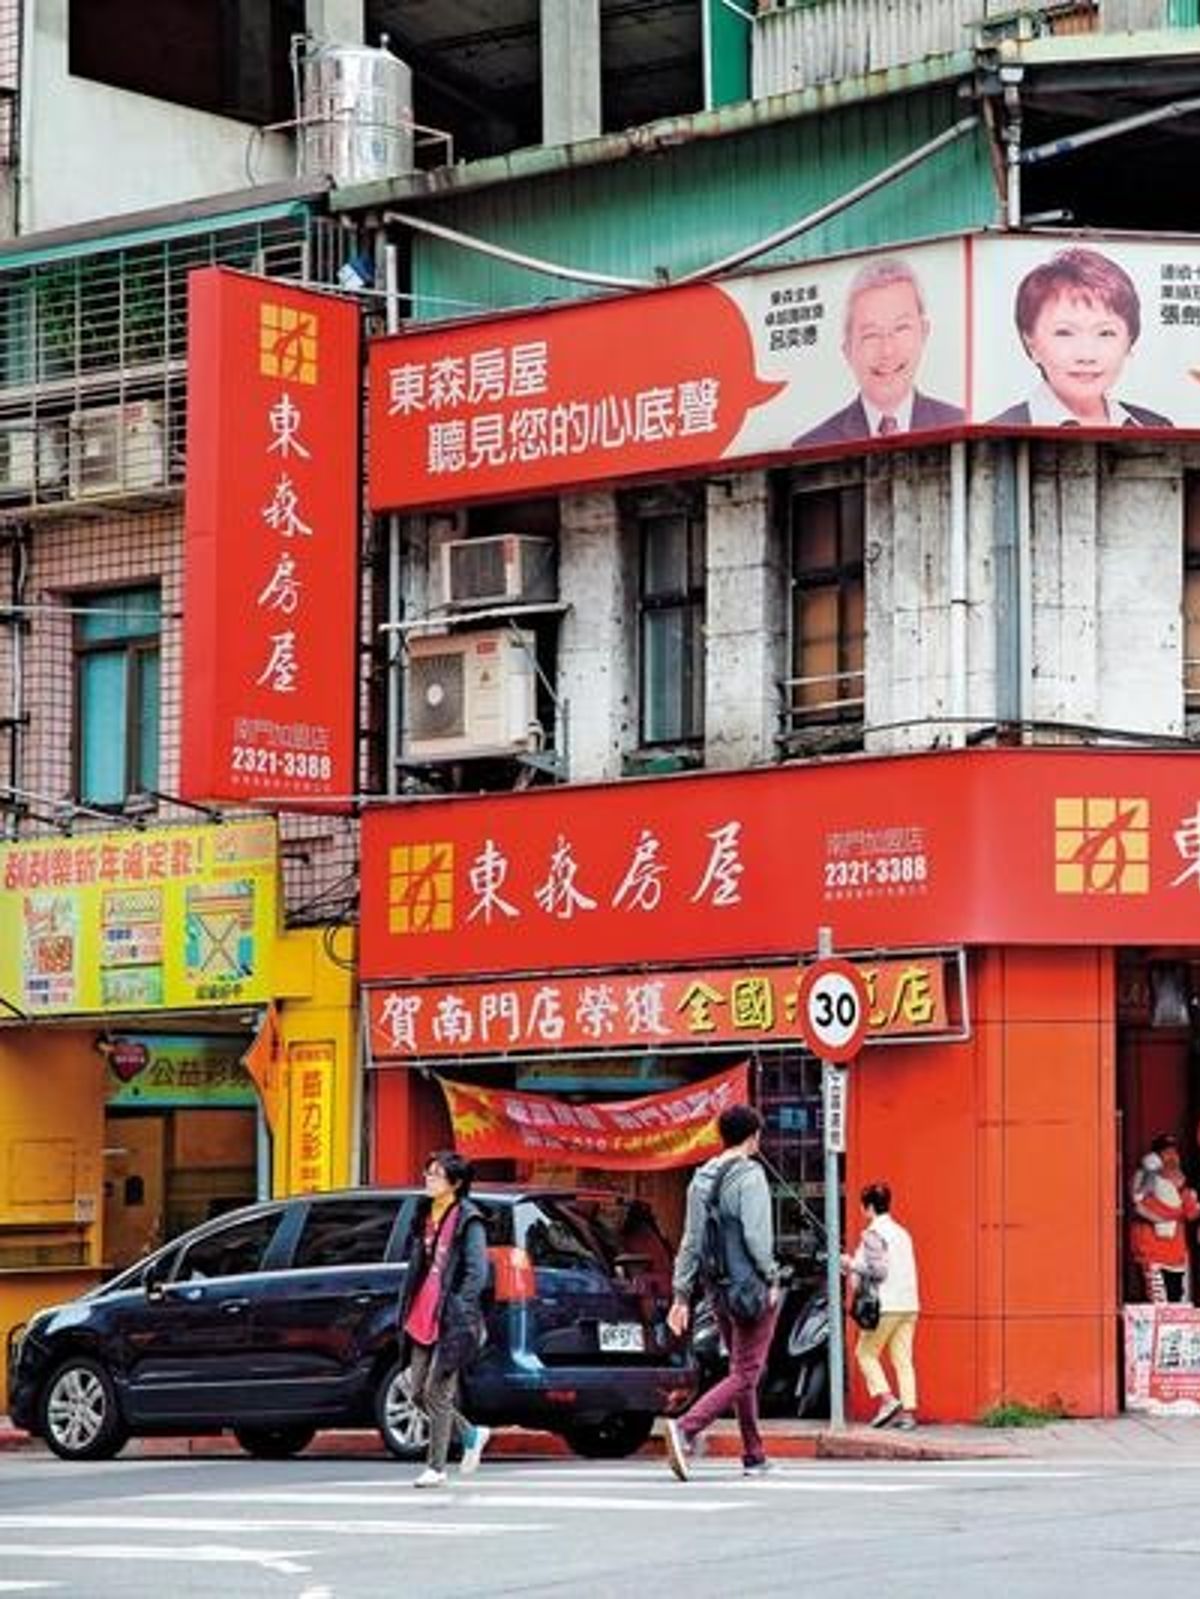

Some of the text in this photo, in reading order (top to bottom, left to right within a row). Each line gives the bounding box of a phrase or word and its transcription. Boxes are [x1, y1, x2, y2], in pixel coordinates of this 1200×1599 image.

[387, 341, 550, 415] 東森房屋
[427, 378, 721, 476] 聽見您的心底聲
[257, 393, 314, 694] 東森房屋
[231, 745, 332, 780] 2321-3388
[466, 820, 744, 925] 東森房屋
[825, 854, 928, 887] 2321-3388
[815, 991, 856, 1027] 30
